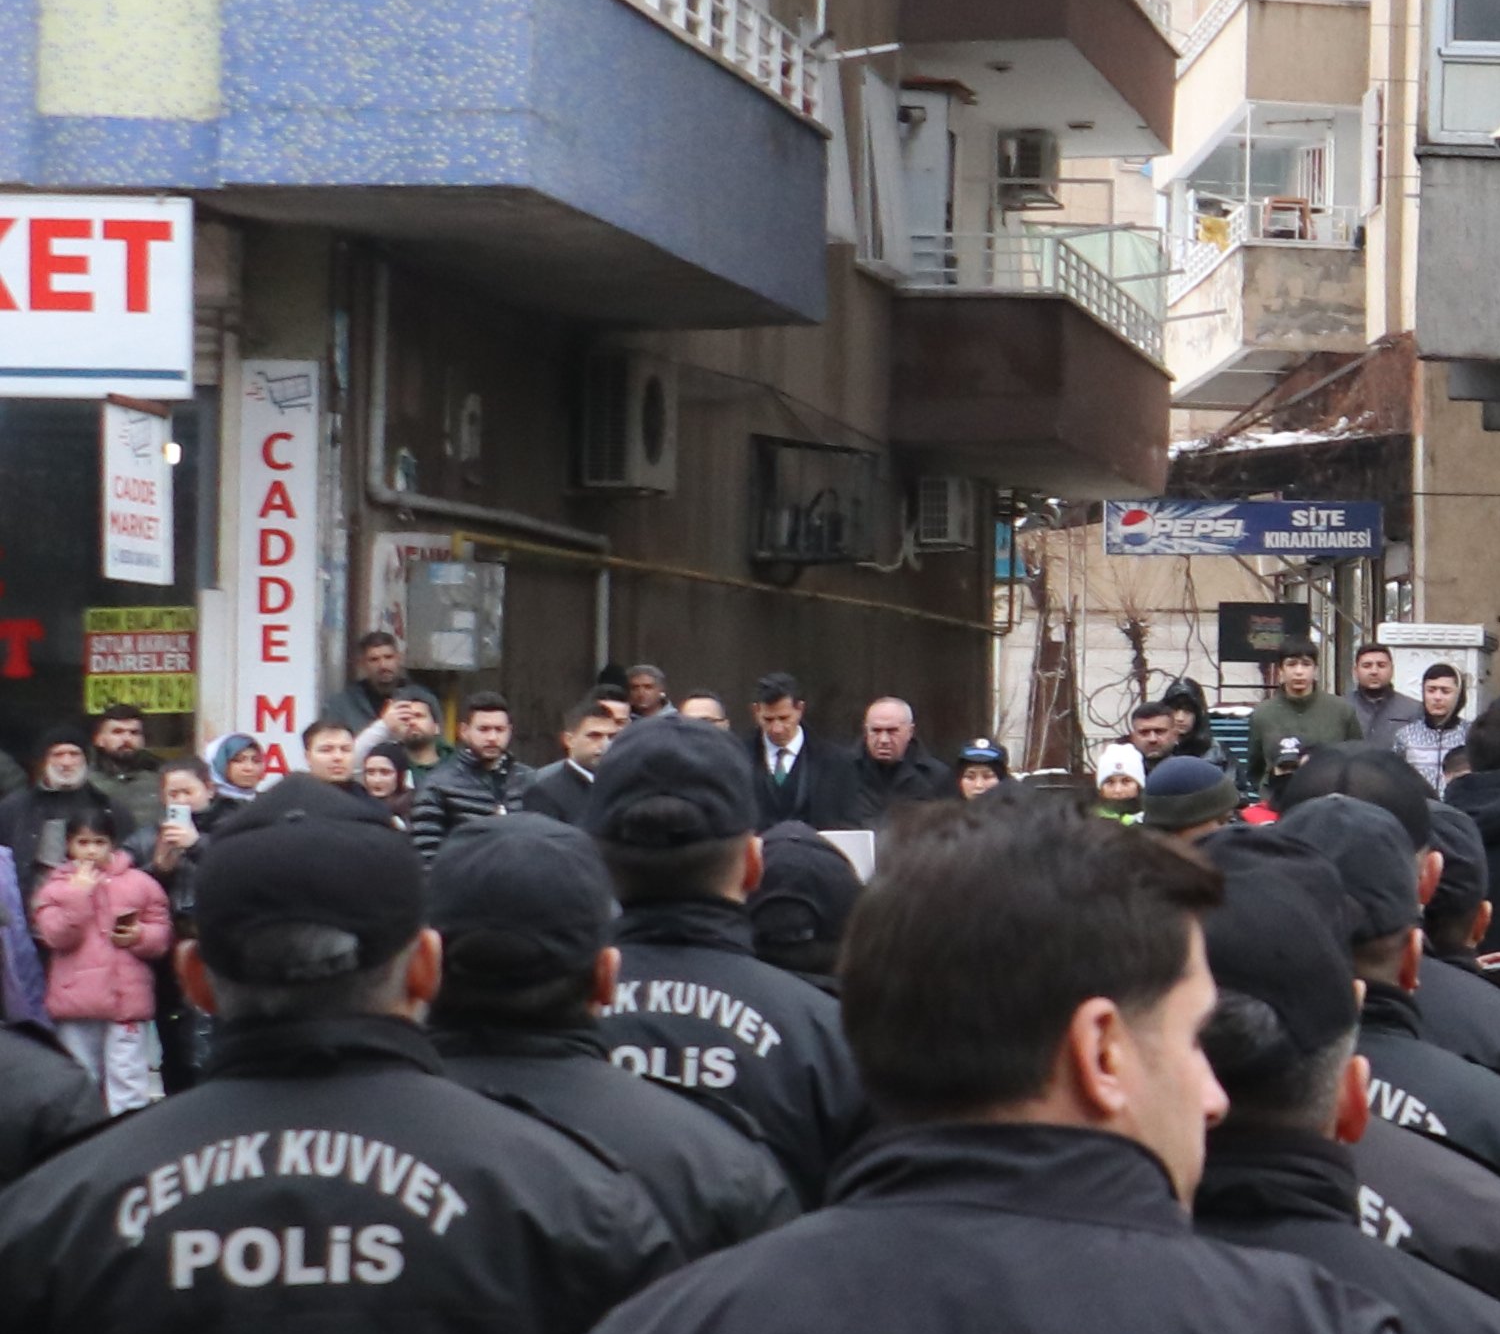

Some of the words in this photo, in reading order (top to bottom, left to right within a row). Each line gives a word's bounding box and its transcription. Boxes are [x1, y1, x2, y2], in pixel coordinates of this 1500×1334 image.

[0, 217, 174, 314] ET
[1151, 519, 1243, 539] PEPSI
[1263, 528, 1372, 549] KIRAATHANESİ
[1291, 506, 1346, 528] SİTE
[648, 980, 782, 1058] KUVVET
[610, 1044, 737, 1089] OLİS
[116, 1131, 270, 1248] ÇEVİK
[276, 1128, 469, 1237] KUVVET
[169, 1223, 406, 1291] POLİS
